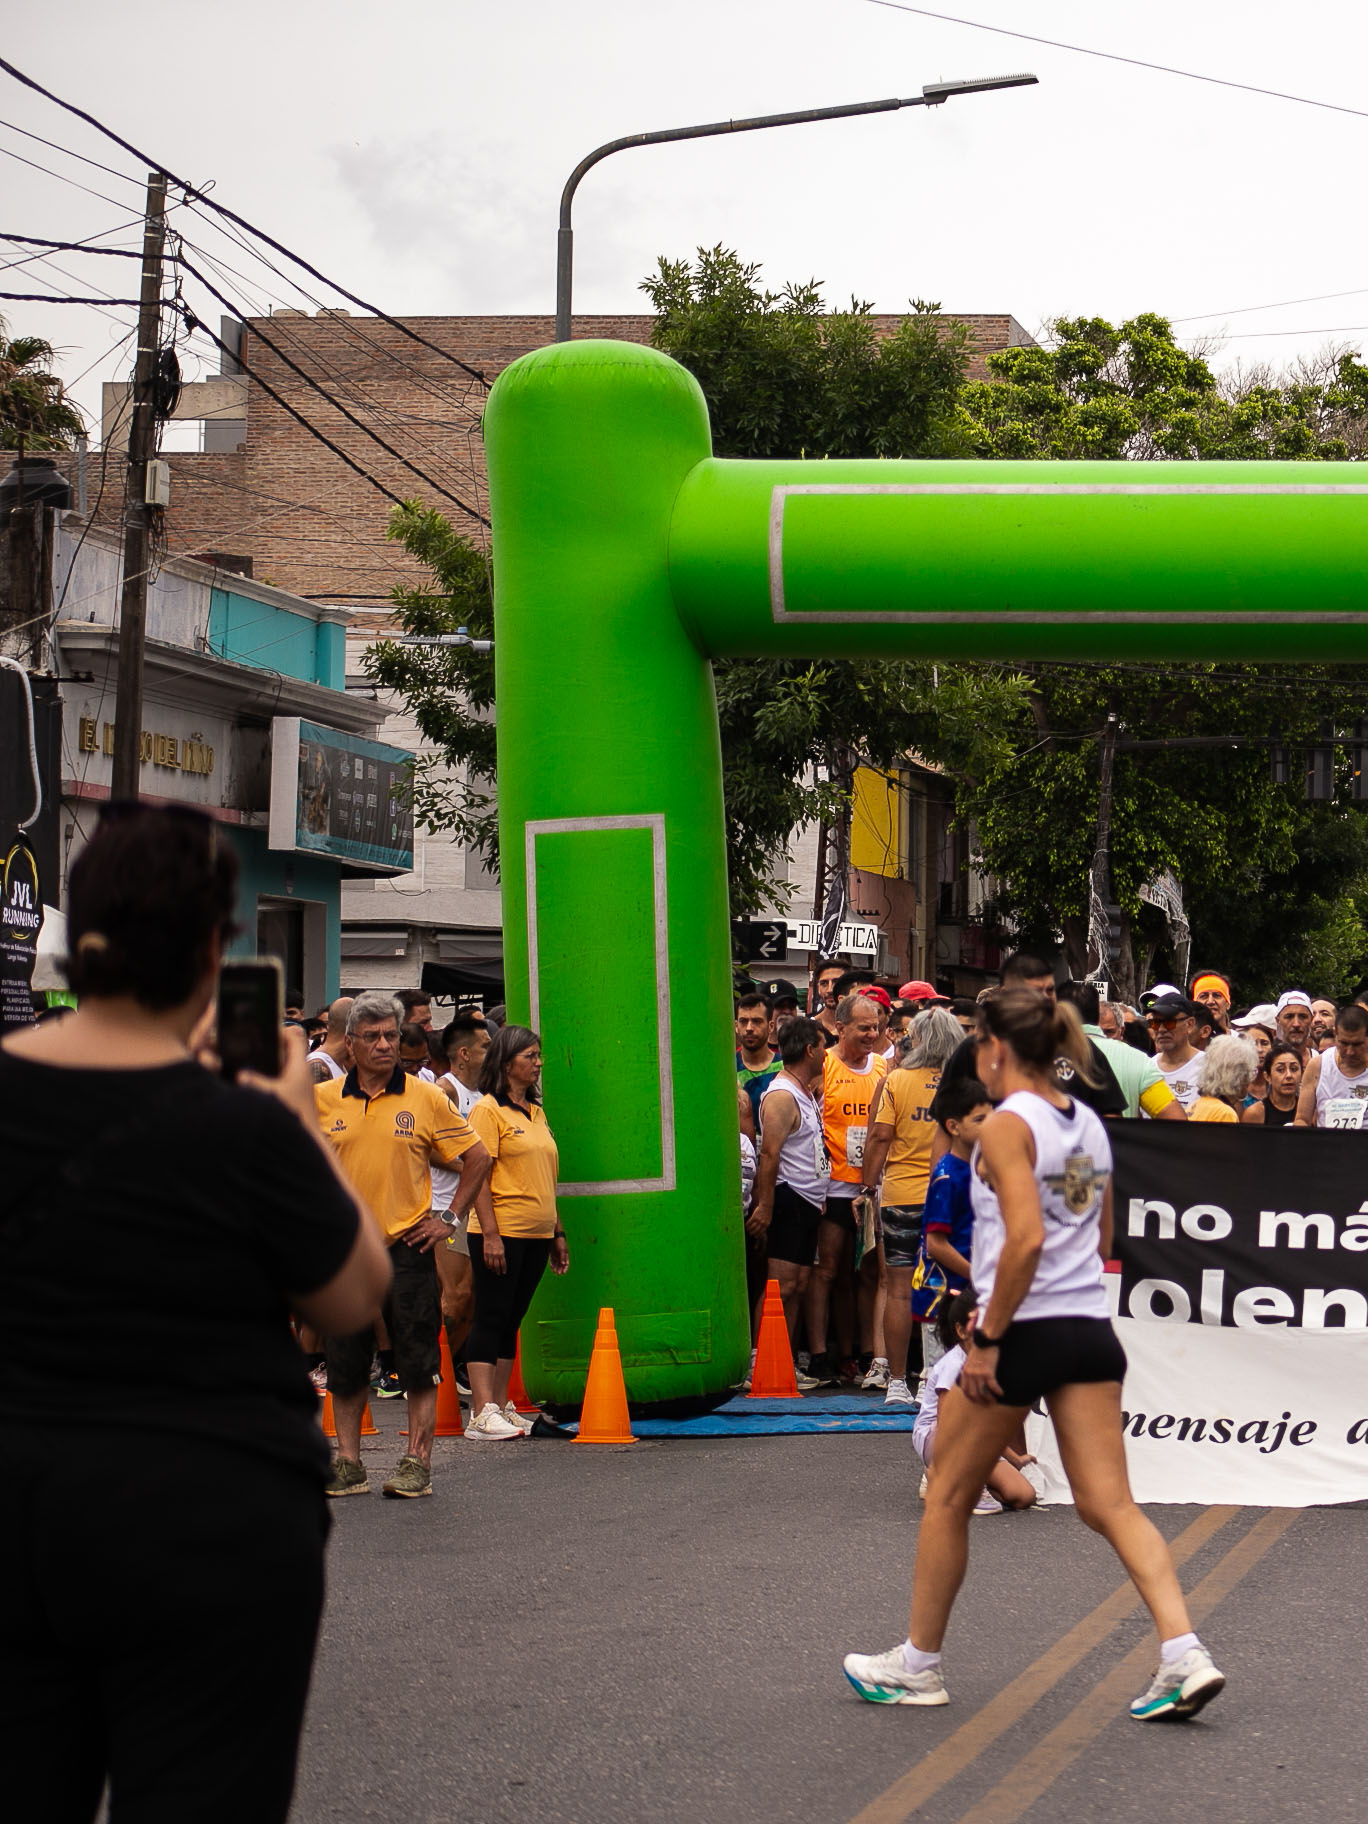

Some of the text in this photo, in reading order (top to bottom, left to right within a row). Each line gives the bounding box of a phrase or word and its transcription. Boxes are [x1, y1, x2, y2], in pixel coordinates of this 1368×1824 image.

[79, 717, 99, 751] EL
[154, 733, 181, 769] DEL
[11, 881, 33, 909] JVL
[3, 907, 39, 928] RUNNING
[1128, 1198, 1233, 1241] no
